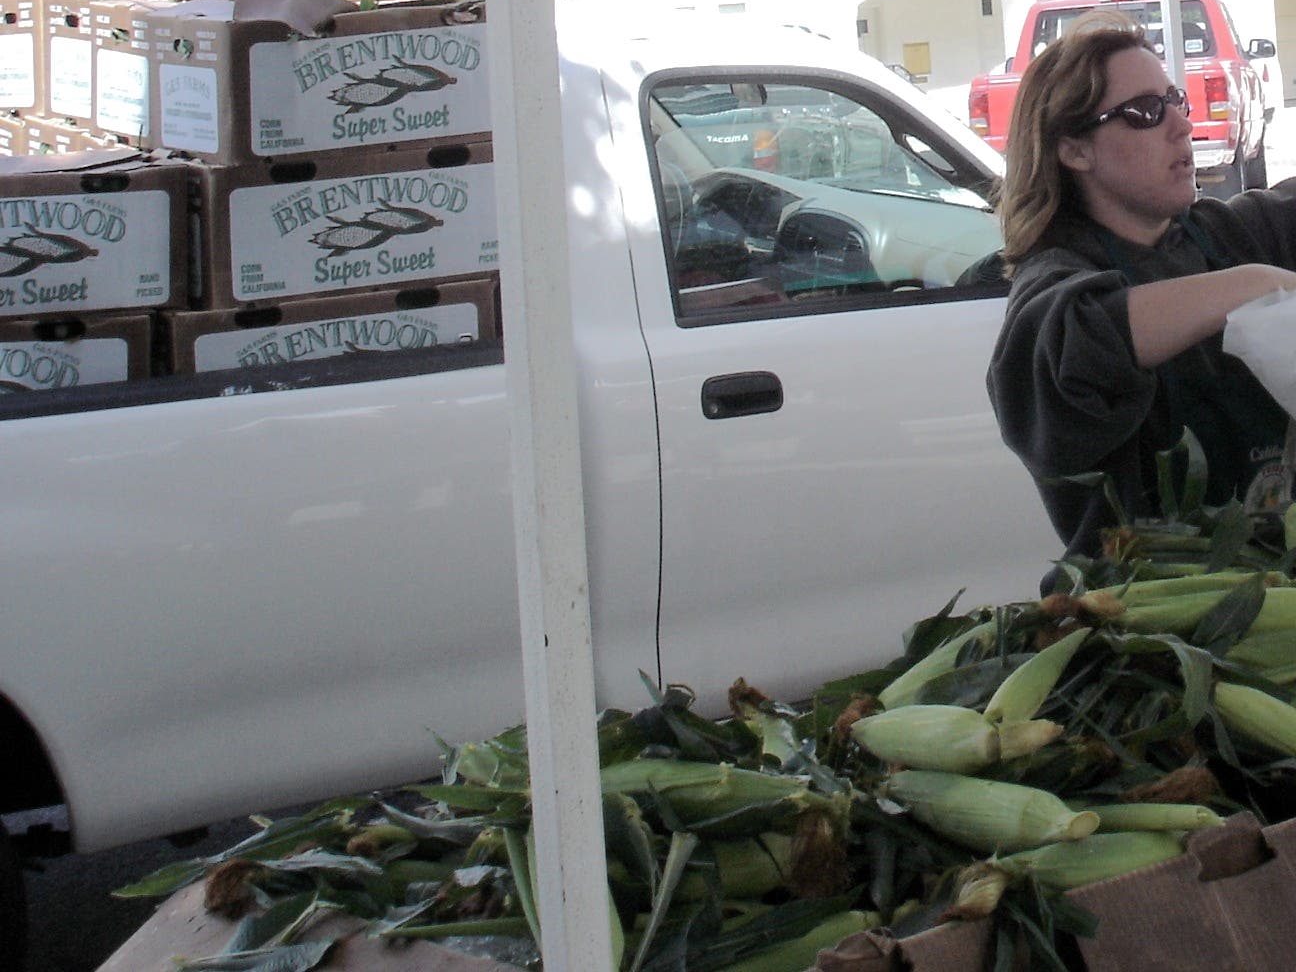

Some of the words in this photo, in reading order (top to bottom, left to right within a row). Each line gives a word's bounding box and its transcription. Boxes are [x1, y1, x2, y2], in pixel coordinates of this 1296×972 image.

[294, 33, 480, 93] BRENTWOOD
[333, 113, 387, 141] Super
[393, 105, 450, 132] Sweet
[706, 134, 749, 143] TACOMA
[0, 200, 126, 242] TWOOD
[272, 177, 468, 238] BRENTWOOD
[314, 257, 371, 285] Super
[377, 246, 435, 275] Sweet
[22, 278, 89, 305] Sweet
